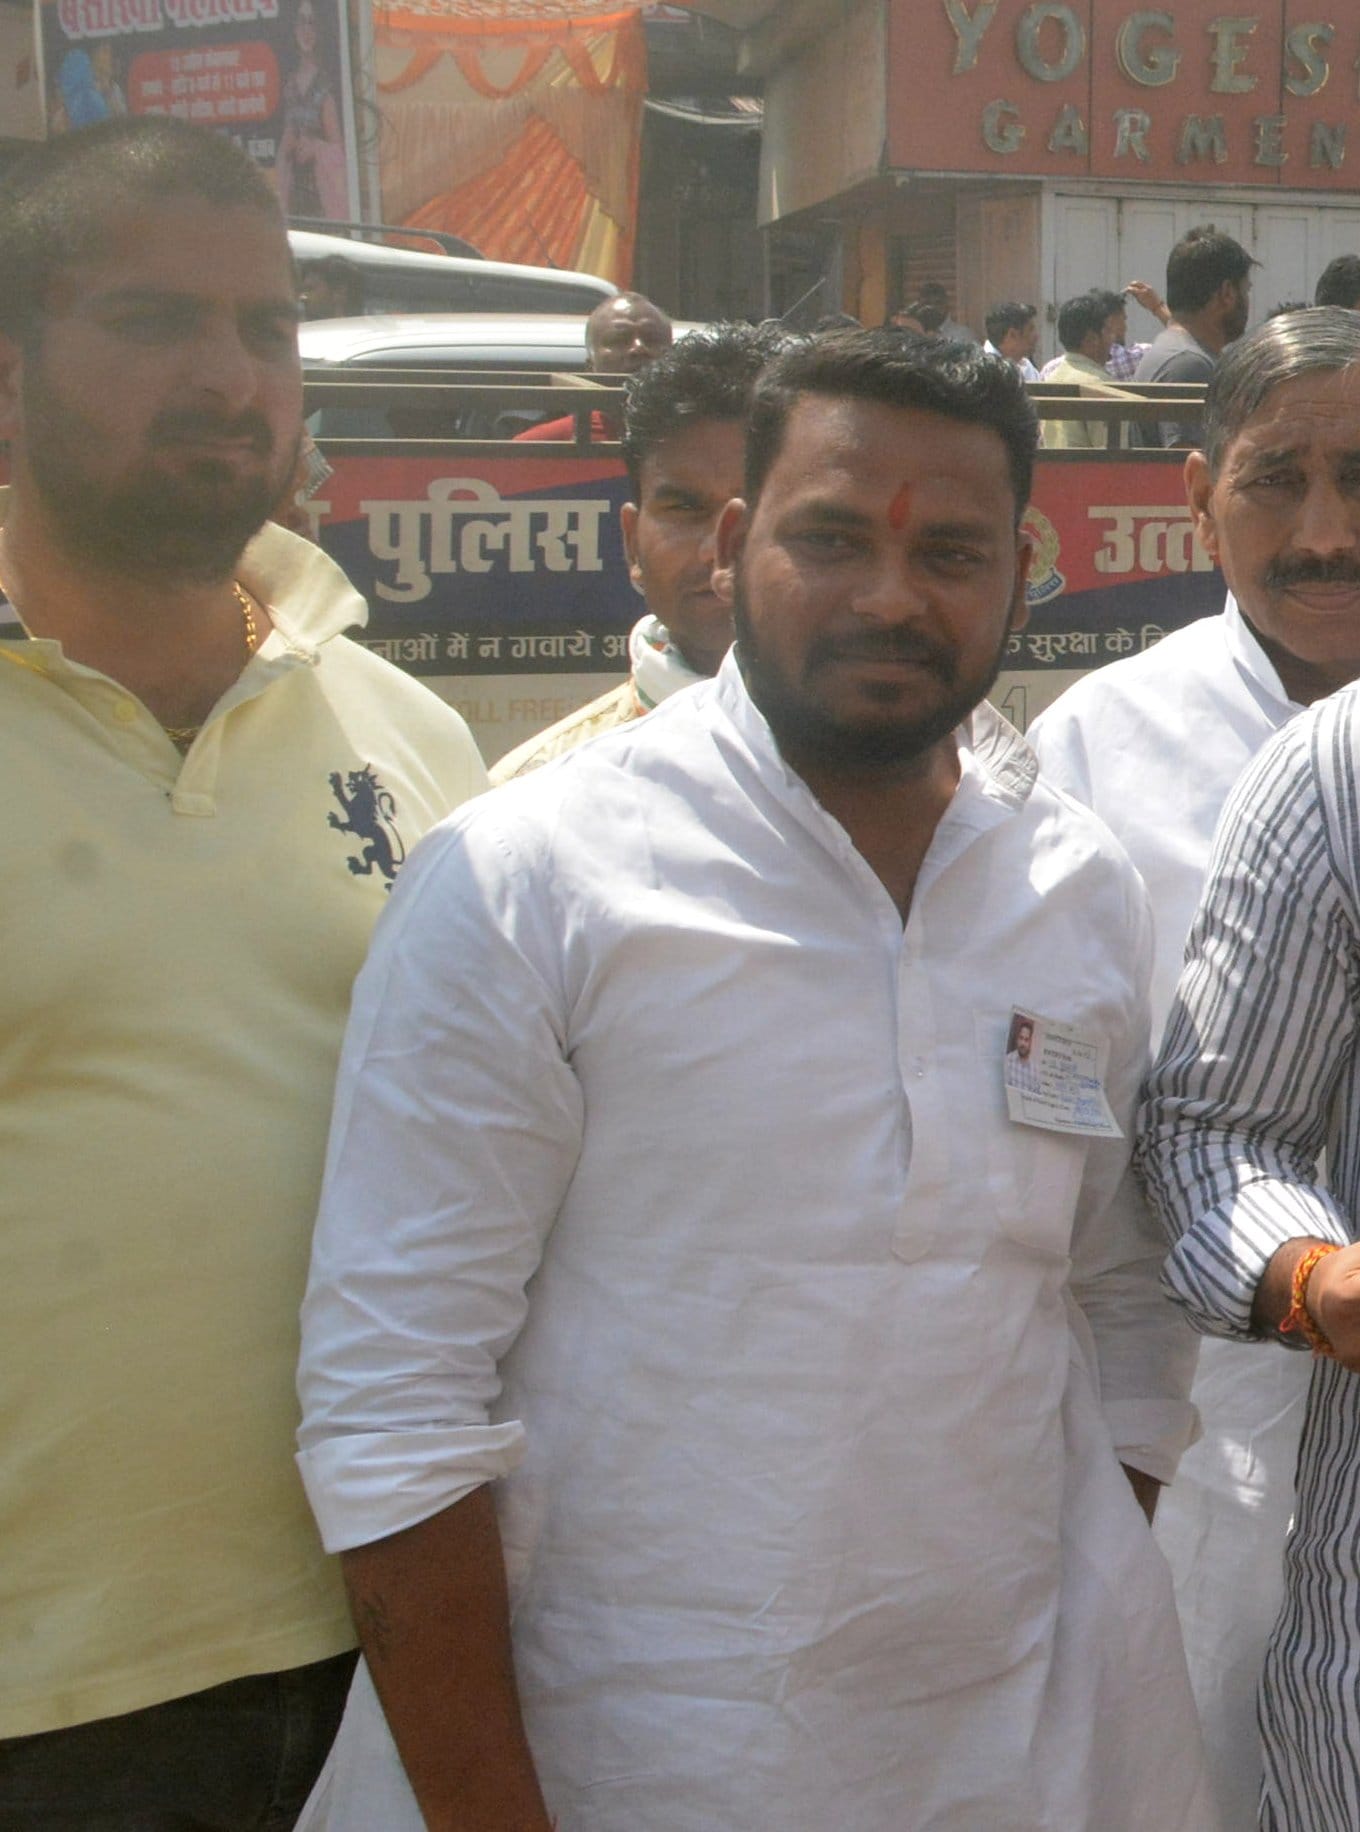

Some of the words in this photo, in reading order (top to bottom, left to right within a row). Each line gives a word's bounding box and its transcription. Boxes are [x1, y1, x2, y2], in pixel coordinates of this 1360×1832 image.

[361, 477, 611, 603] पुलिस
[446, 632, 470, 660] में
[1027, 631, 1100, 662] सुरक्षा
[1104, 627, 1136, 652] के
